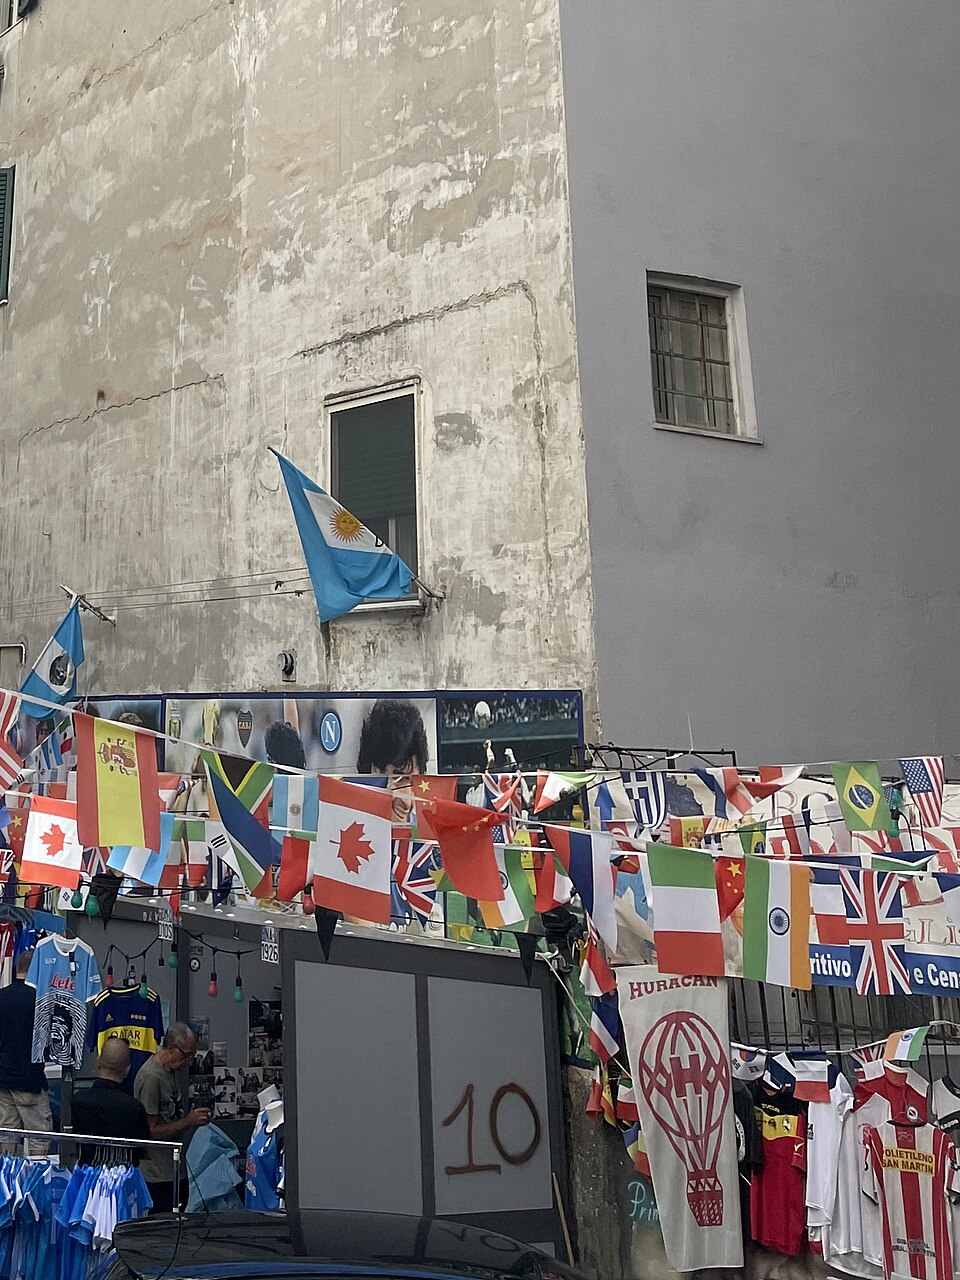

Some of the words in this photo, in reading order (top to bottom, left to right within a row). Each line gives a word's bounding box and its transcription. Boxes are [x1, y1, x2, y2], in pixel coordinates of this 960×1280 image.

[325, 721, 336, 743] N
[262, 943, 279, 962] 1926
[48, 973, 76, 990] Lete
[442, 1082, 541, 1176] 10
[883, 1148, 933, 1164] OLIETILENO
[882, 1159, 900, 1168] SAN
[901, 1161, 934, 1174] MARTIN
